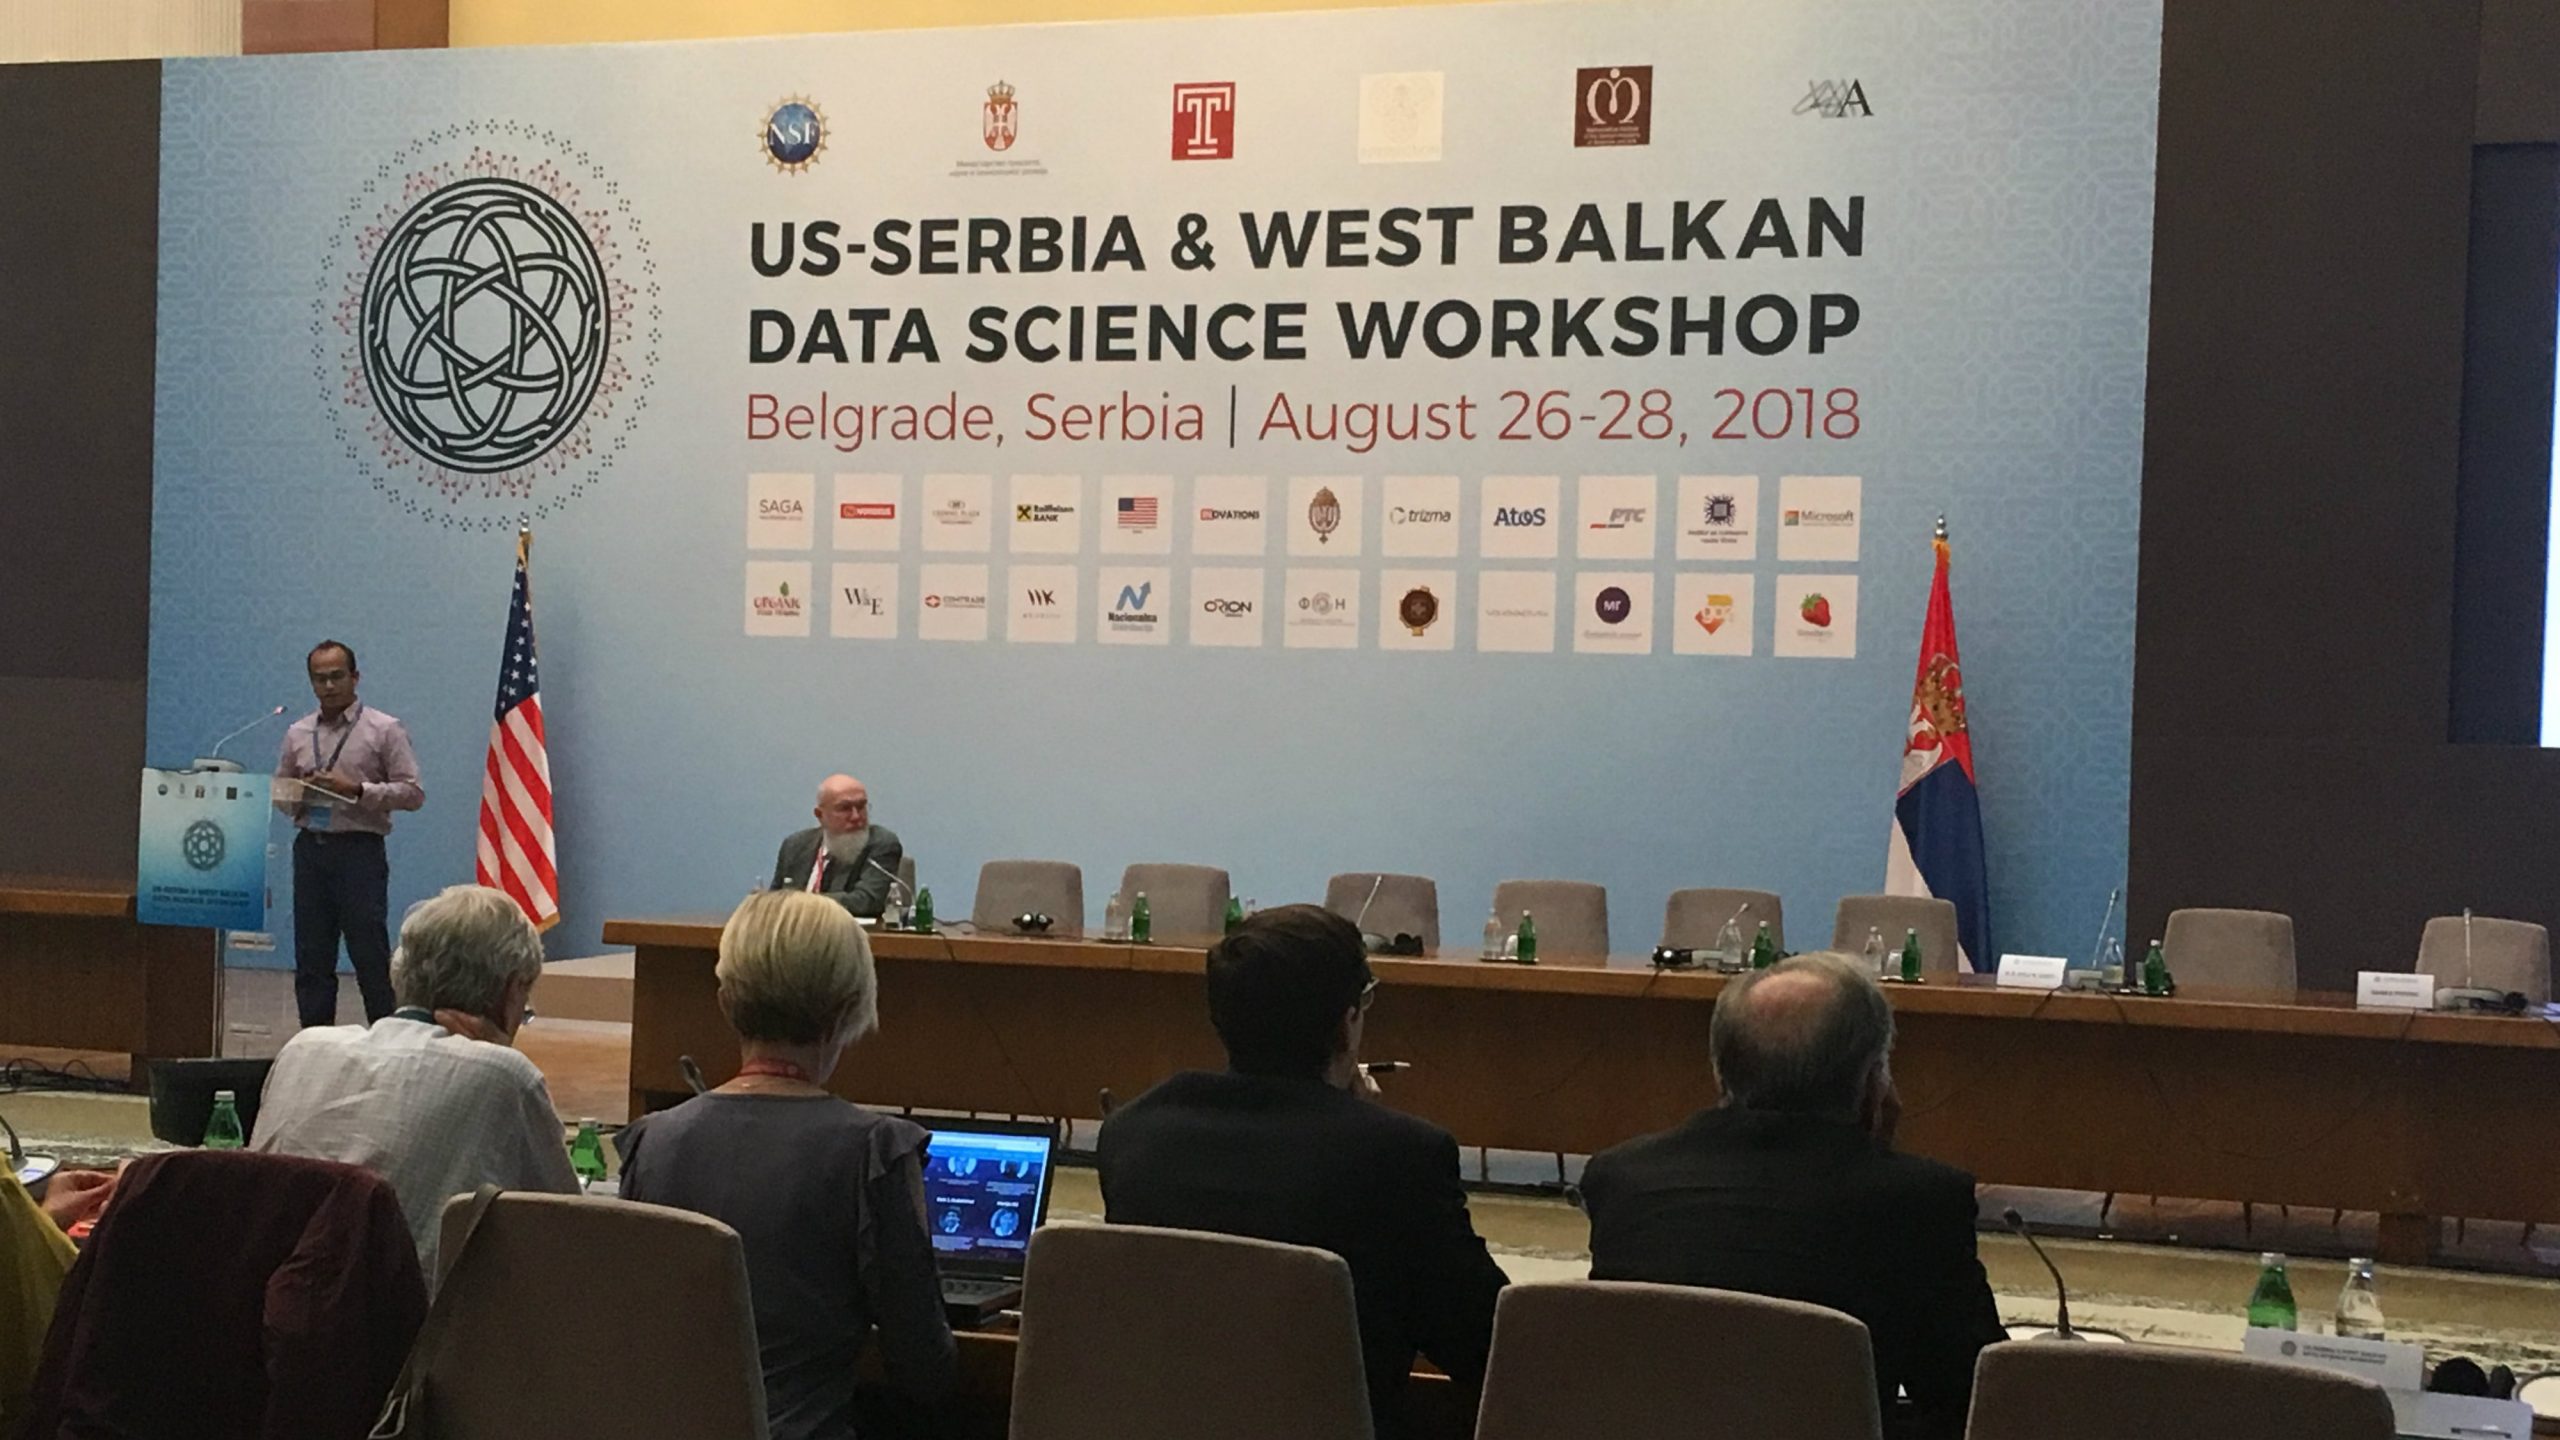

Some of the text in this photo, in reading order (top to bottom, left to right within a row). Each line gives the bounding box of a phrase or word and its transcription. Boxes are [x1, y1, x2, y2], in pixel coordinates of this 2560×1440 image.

[751, 196, 1865, 278] US-SERBIA & WEST BALKAN
[749, 293, 1860, 364] DATA SCIENCE WORKSHOP
[747, 387, 1860, 454] Belgrade, Serbia August 26-28, 2018
[759, 499, 803, 513] SAGA
[1033, 514, 1059, 522] BANK
[1408, 508, 1452, 522] trizma
[1801, 510, 1854, 522] Microsoft
[1204, 599, 1253, 613] ORION
